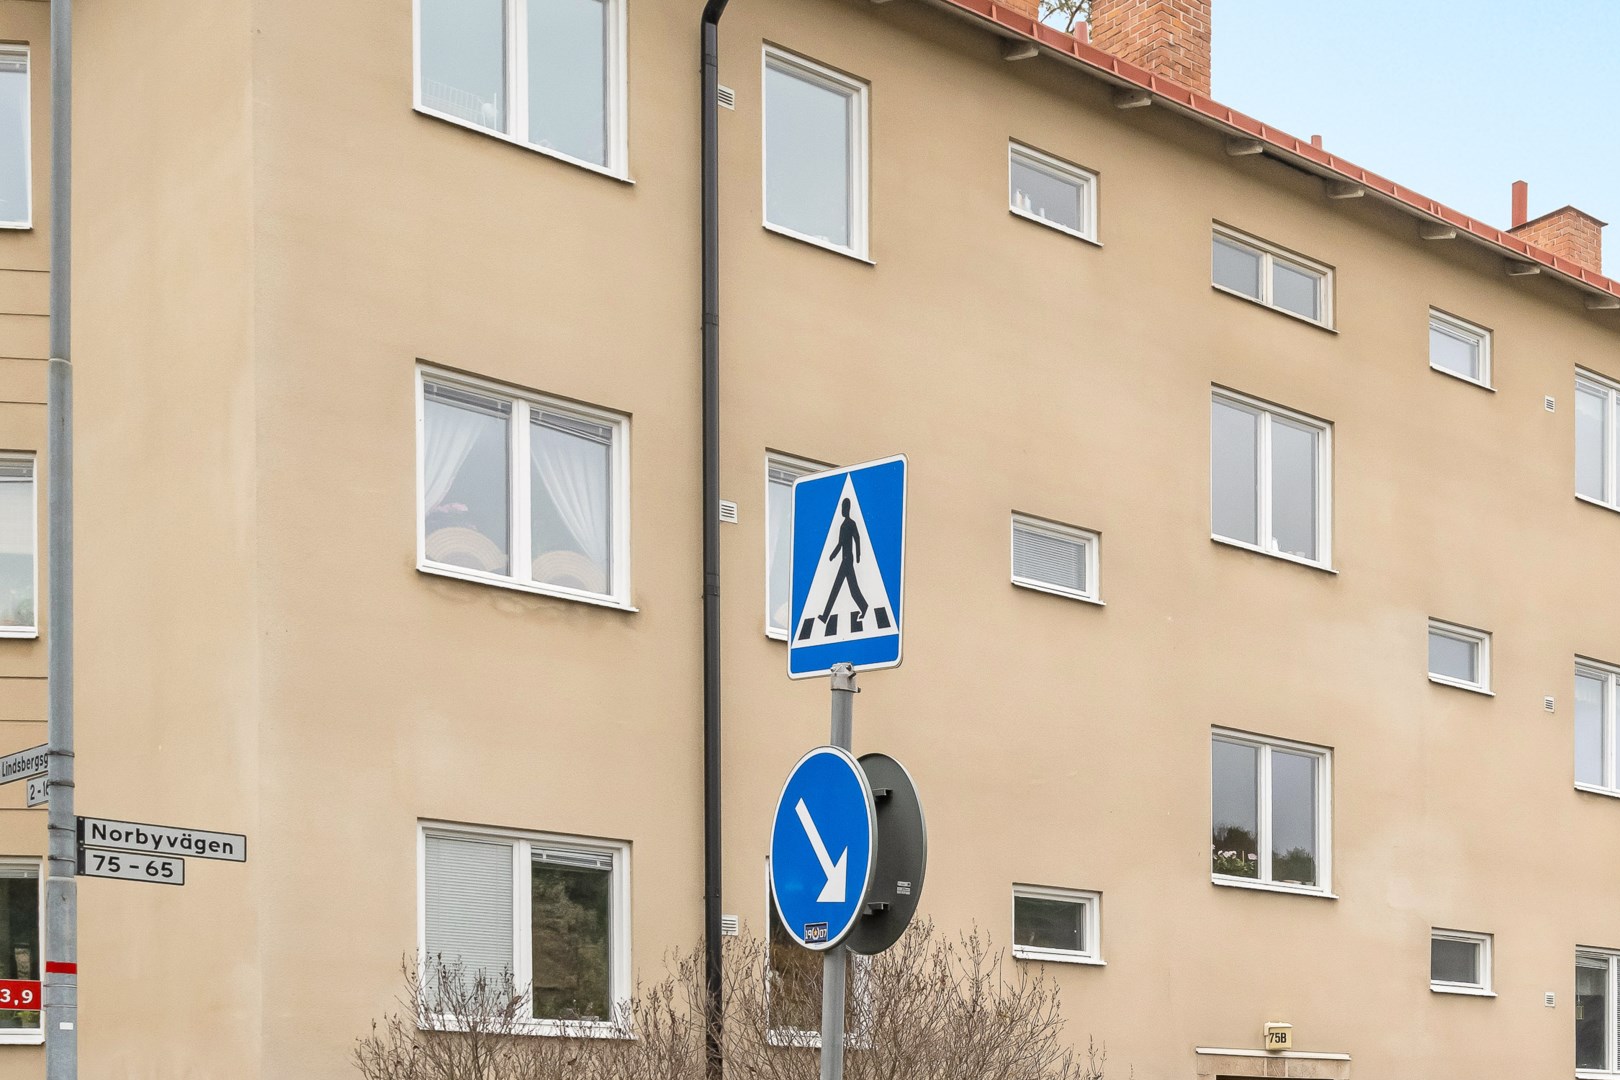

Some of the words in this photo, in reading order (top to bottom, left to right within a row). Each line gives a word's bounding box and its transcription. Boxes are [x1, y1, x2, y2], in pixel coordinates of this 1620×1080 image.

[30, 784, 35, 800] 2
[92, 823, 234, 855] Norbyvägen
[93, 854, 121, 873] 75
[145, 860, 174, 878] 65
[0, 988, 33, 1006] 3,9
[1269, 1032, 1287, 1044] 75B
